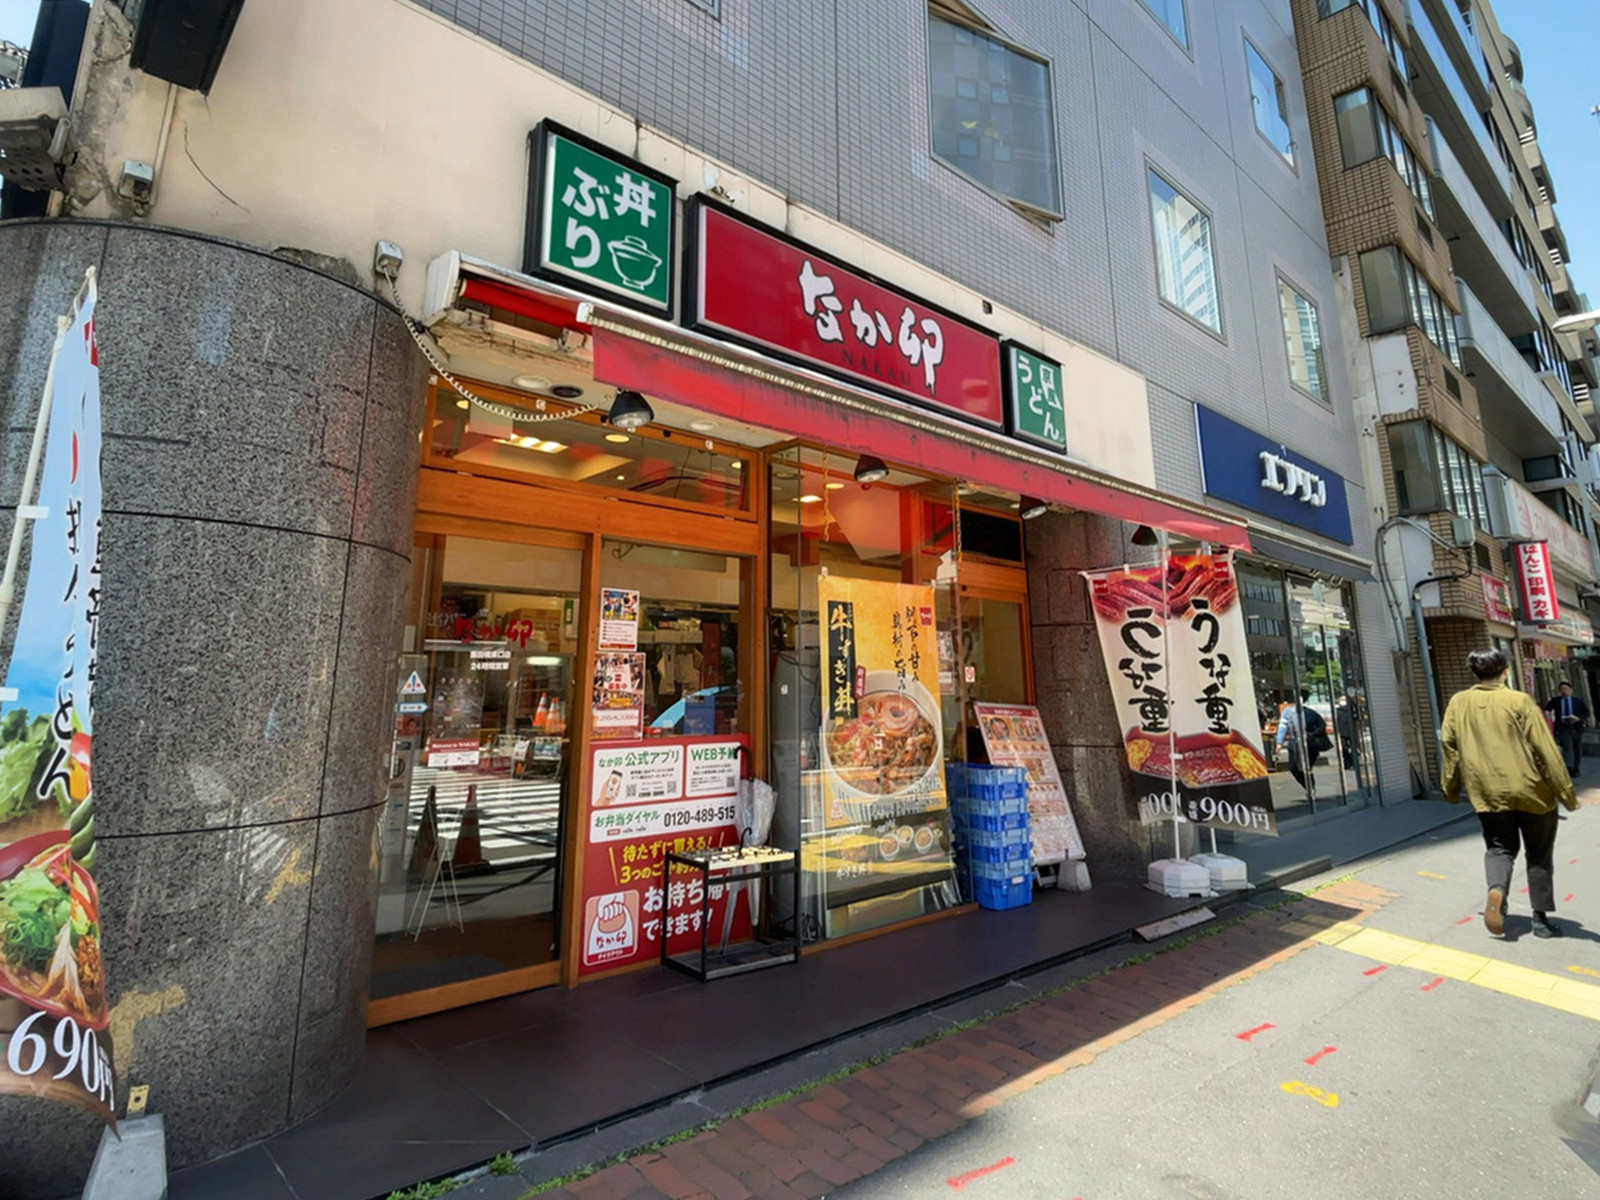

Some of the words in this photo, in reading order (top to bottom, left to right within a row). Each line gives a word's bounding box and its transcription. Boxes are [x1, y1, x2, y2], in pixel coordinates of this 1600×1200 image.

[798, 259, 944, 396] なか卯
[830, 604, 855, 716] 牛すき丼
[1190, 598, 1234, 734] うな重
[625, 749, 679, 767] 公式アプリ
[594, 810, 661, 829] お弁当ダイヤル
[664, 805, 736, 828] 0120-489-515
[1200, 796, 1271, 831] 900円
[7, 1010, 115, 1112] 690円
